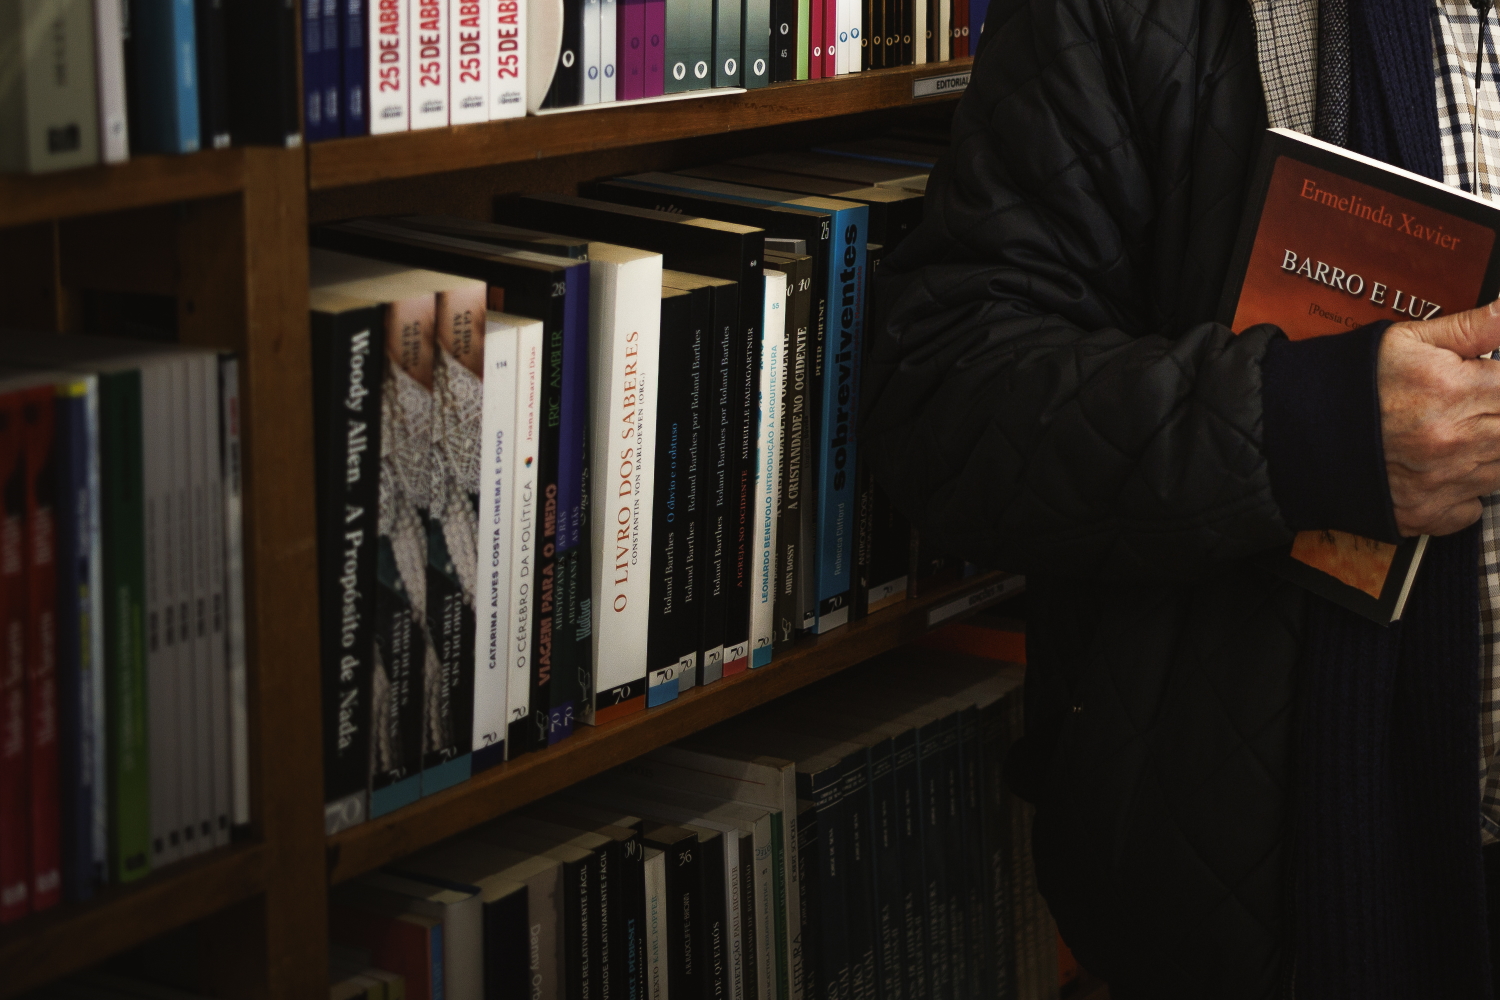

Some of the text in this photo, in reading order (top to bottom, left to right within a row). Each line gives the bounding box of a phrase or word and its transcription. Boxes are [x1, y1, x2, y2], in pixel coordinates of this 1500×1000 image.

[380, 38, 399, 64] DE
[420, 33, 440, 59] DE
[460, 30, 480, 56] DE
[498, 27, 518, 52] DE
[380, 66, 400, 93] 25
[420, 61, 441, 88] 25
[460, 57, 481, 84] 25
[498, 55, 519, 79] 25
[820, 221, 830, 240] 25
[1299, 178, 1461, 251] Ermelinda Xavier
[1280, 248, 1442, 322] BARRO E LUZ
[344, 328, 371, 412] Woody
[831, 224, 858, 492] sobreviventes
[547, 329, 562, 427] ERIC AMBLER
[767, 345, 778, 420] ARQUITECTURA
[495, 430, 503, 463] POVO
[668, 423, 678, 460] obtuso
[612, 331, 639, 613] O LIVRO DOS SABERES
[763, 431, 776, 495] INTRODUÇÃO
[344, 503, 365, 525] A
[493, 478, 502, 524] CINEMA
[666, 480, 676, 510] óbvio
[665, 513, 675, 523] O
[762, 497, 772, 548] BENEVOLO
[491, 528, 500, 567] COSTA
[833, 502, 845, 575] Rebecca Clifford
[338, 528, 365, 648] Propósito
[490, 571, 498, 607] ALVES
[514, 479, 533, 668] O CÉREBRO DA POLÍTICA
[538, 482, 558, 686] VIAGEM PARA O MEDO
[662, 532, 675, 615] Roland Barthes
[760, 550, 770, 604] LEONARDO
[488, 611, 497, 669] CATARINA
[340, 655, 361, 683] de
[656, 668, 674, 685] 70
[612, 685, 631, 705] 70
[678, 850, 692, 867] 36
[579, 864, 589, 977] RELATIVAMENTE FÁCIL
